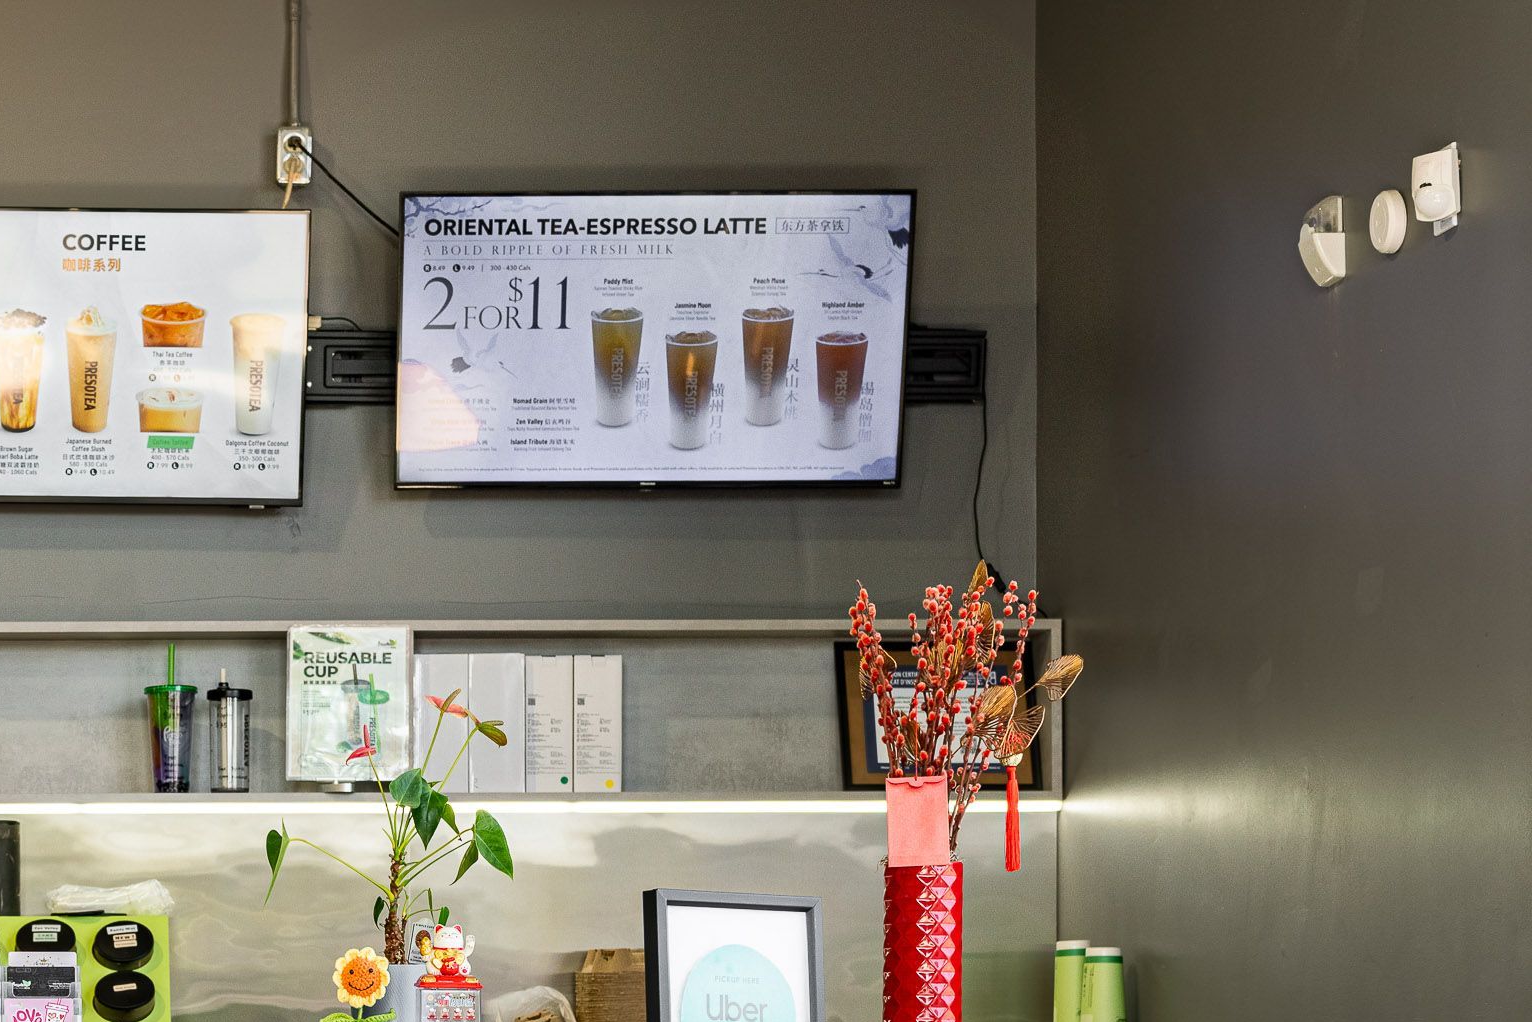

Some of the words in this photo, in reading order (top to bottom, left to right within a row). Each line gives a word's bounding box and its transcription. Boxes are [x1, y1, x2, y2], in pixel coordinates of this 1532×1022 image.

[424, 218, 532, 236] ORIENTAL
[538, 218, 697, 235] TEA-ESPRESSO
[704, 218, 766, 235] LATTE
[781, 221, 844, 232] 东方茶拿铁
[62, 234, 146, 251] COFFEE
[423, 245, 432, 256] A
[442, 245, 482, 256] BOLD
[492, 245, 543, 256] RIPPLE
[552, 245, 572, 256] OF
[582, 244, 628, 255] FRESH
[637, 244, 674, 255] MILK
[62, 258, 122, 272] 咖啡系列
[423, 276, 457, 330] 2
[464, 306, 522, 330] FOR
[84, 361, 98, 411] PRESOTEA
[249, 360, 264, 412] PRESOTEA
[304, 651, 392, 665] REUSABLE
[304, 665, 338, 678] CUP
[714, 976, 740, 984] PICKUP
[742, 977, 760, 985] HERE
[706, 994, 768, 1022] Uber
